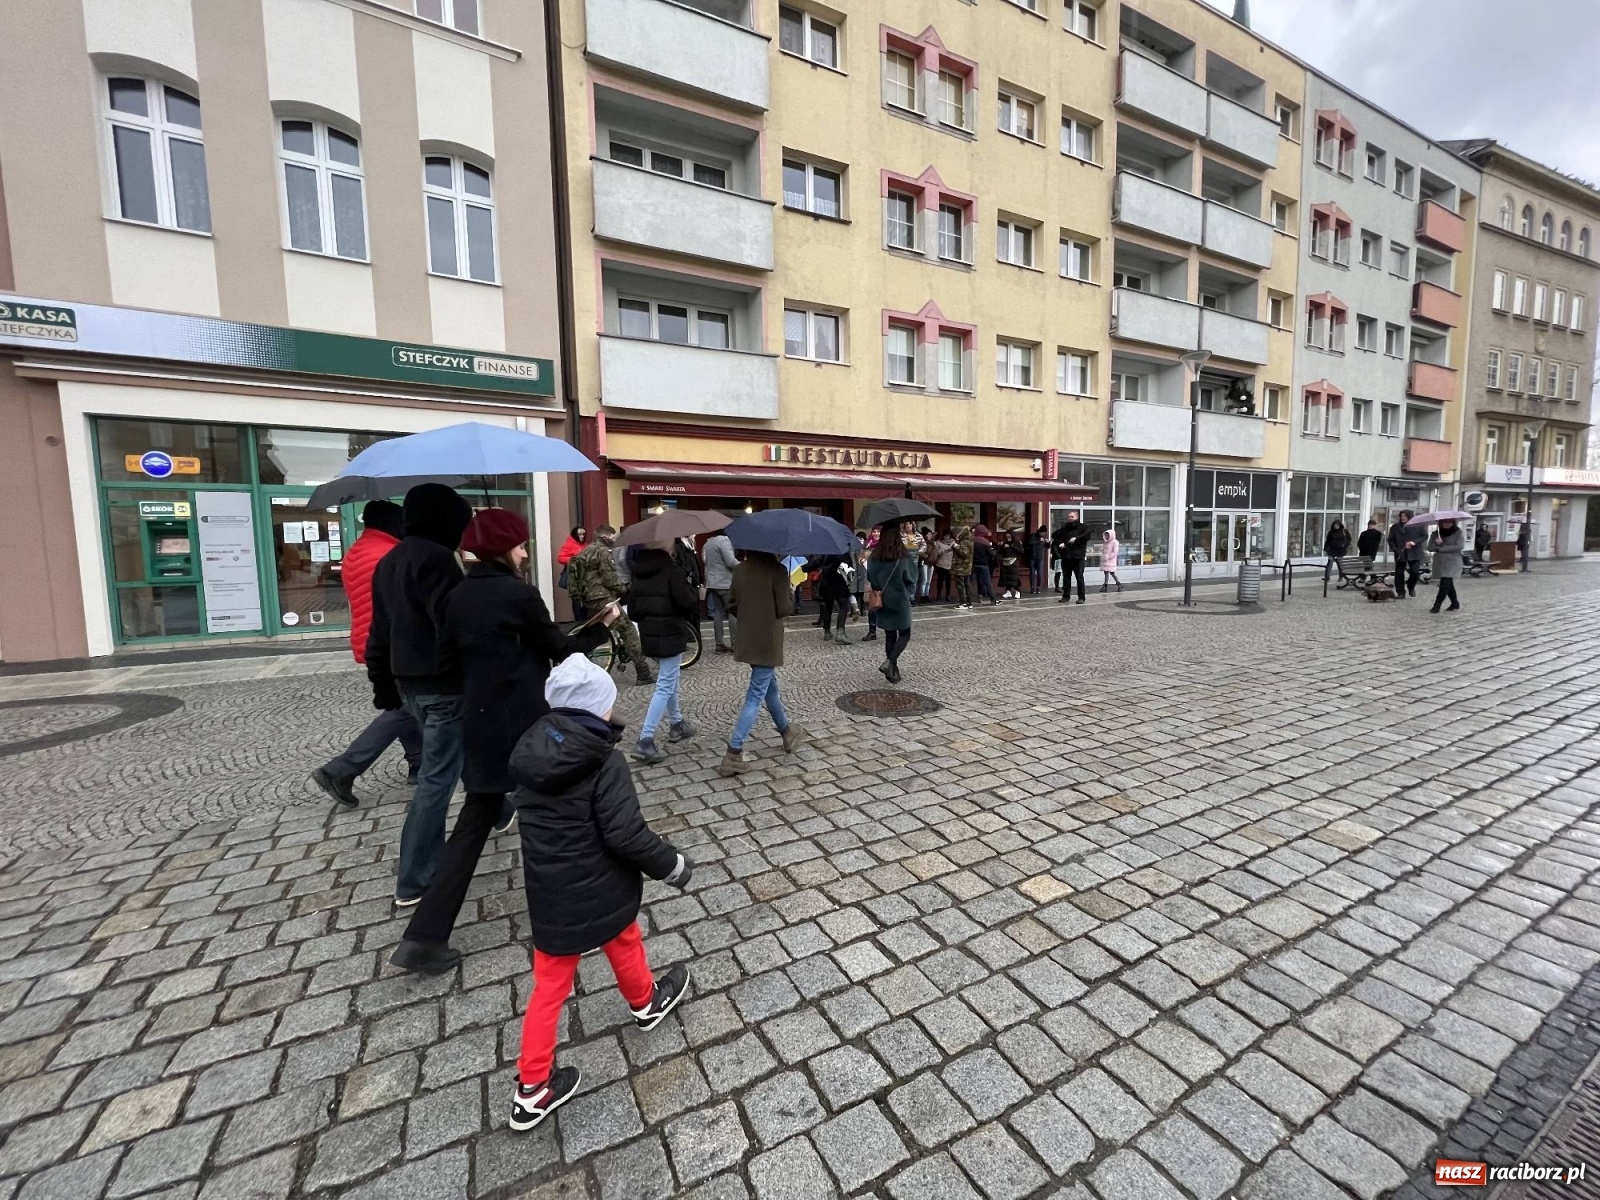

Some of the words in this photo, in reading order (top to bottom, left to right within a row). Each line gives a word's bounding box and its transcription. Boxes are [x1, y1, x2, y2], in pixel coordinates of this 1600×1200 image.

[16, 306, 72, 324] KASA
[0, 323, 74, 339] TEFCZYKA
[399, 350, 470, 369] STEFCZYK
[477, 360, 533, 376] FINANSE
[788, 446, 931, 469] RESTAURACJA
[1218, 480, 1247, 498] empik
